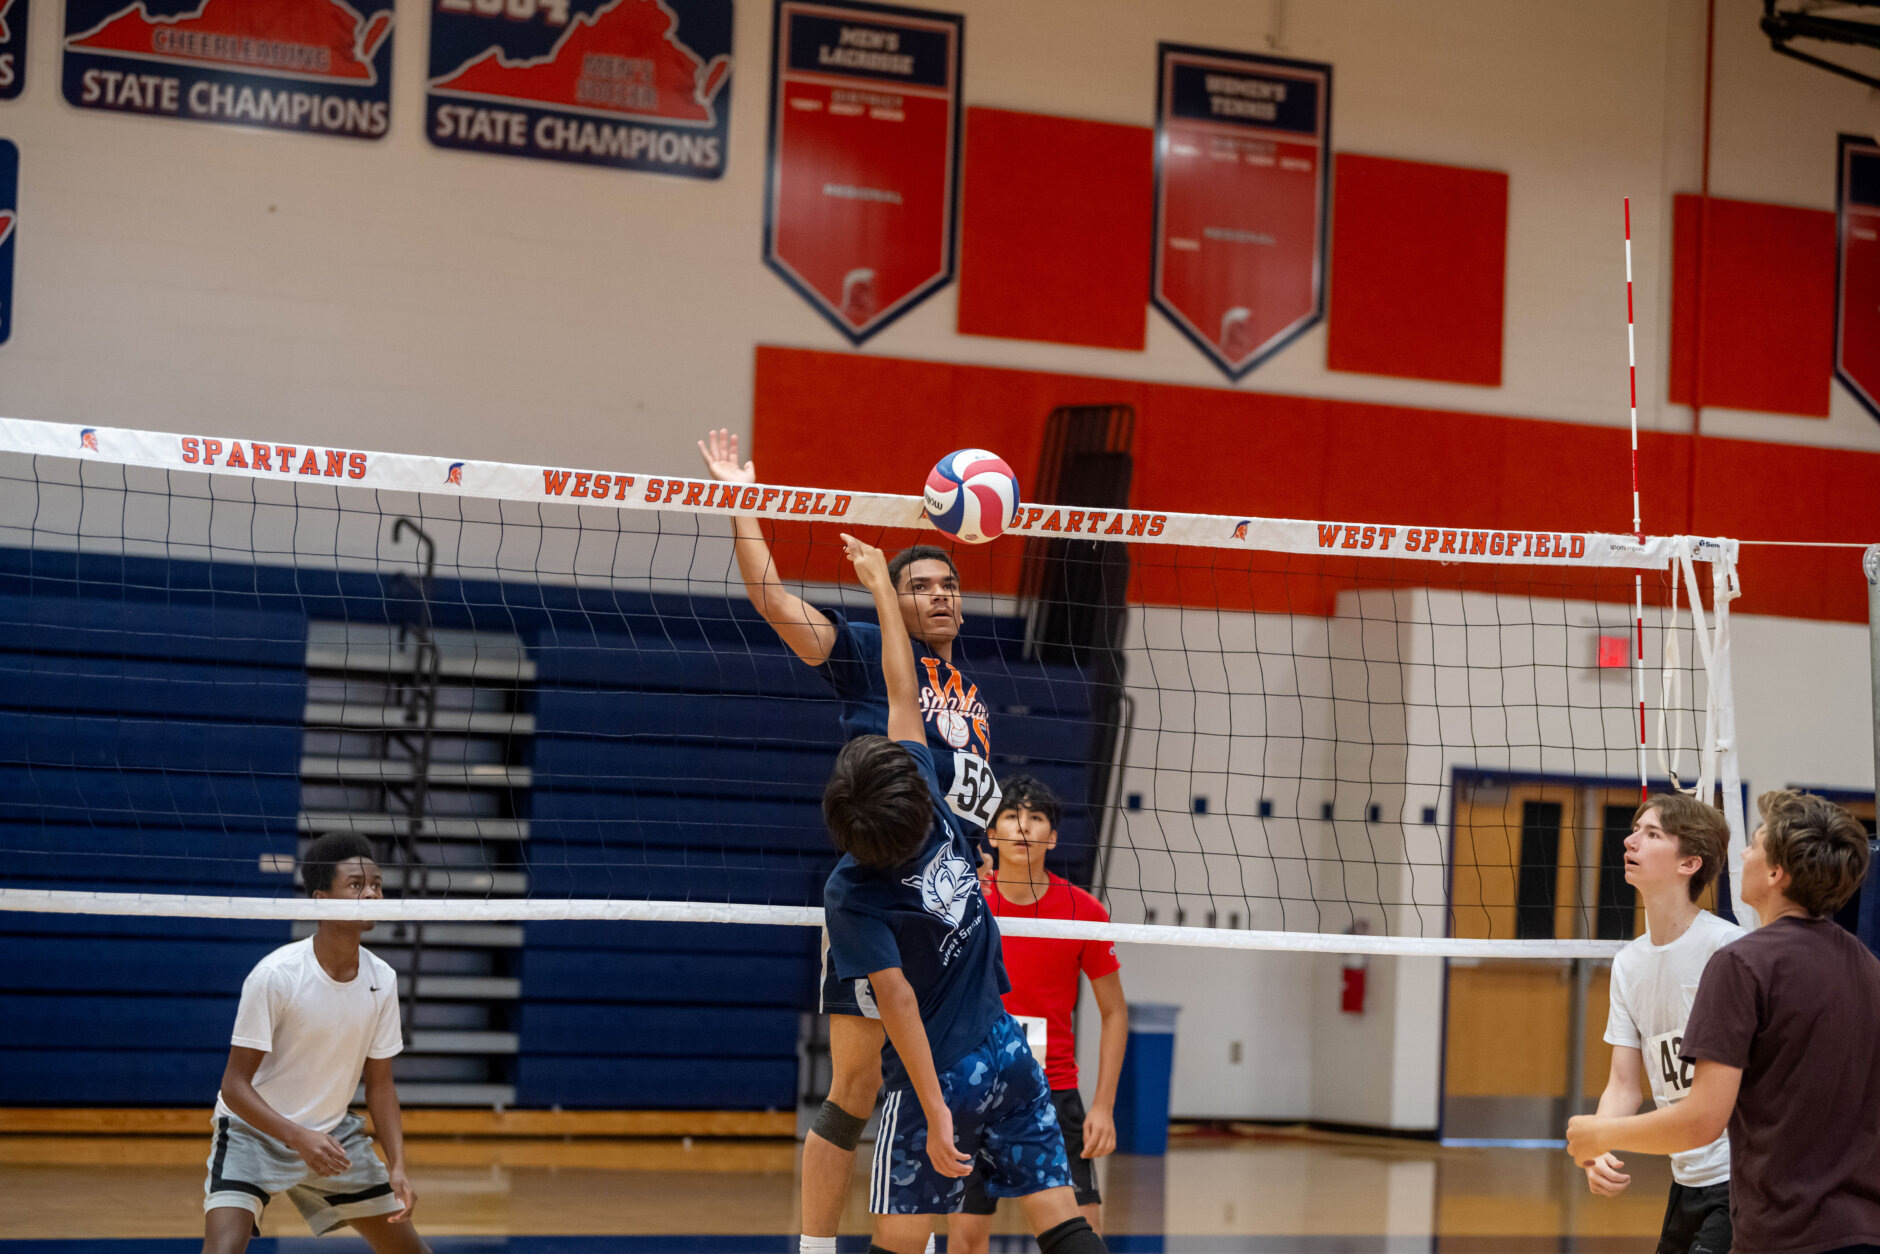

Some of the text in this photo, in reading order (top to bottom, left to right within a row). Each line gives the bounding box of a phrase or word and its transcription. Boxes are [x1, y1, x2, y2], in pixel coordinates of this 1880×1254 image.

[153, 28, 331, 71] CHEERLEADING
[818, 45, 914, 75] LACROSSE
[839, 26, 900, 51] MEN'S
[82, 69, 387, 134] STATE CHAMPIONS
[436, 105, 720, 168] STATE CHAMPIONS
[181, 437, 367, 480] SPARTANS
[542, 469, 852, 517] WEST SPRINGFIELD
[1317, 524, 1586, 559] WEST SPRINGFIELD
[956, 757, 996, 822] 52
[1660, 1036, 1694, 1092] 42
